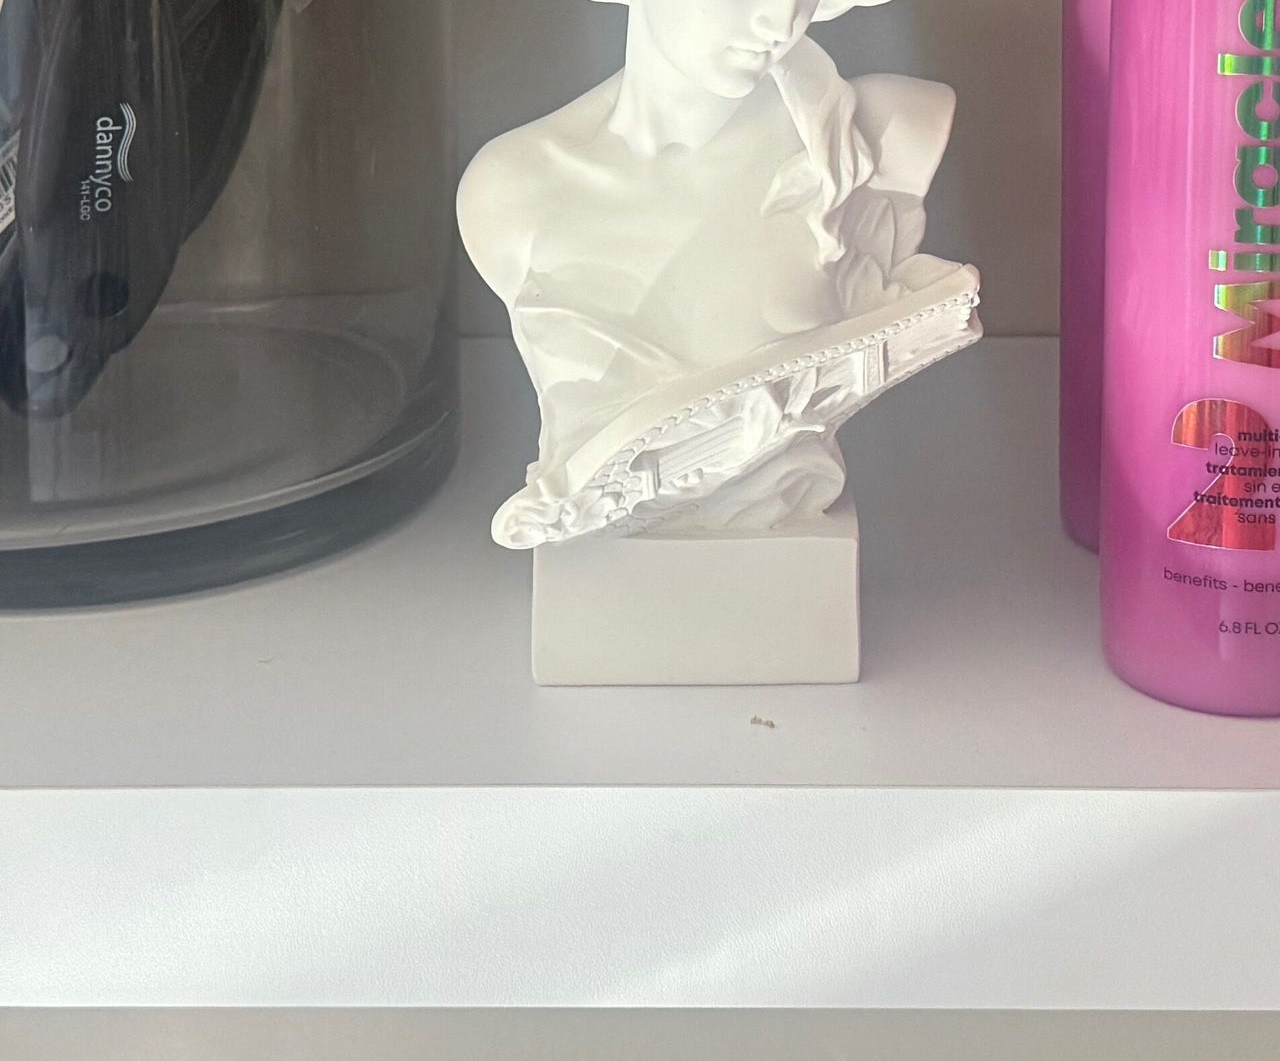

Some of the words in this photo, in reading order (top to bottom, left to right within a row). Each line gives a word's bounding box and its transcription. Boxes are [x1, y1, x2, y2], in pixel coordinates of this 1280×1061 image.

[89, 116, 122, 212] dannyco
[1215, 442, 1280, 459] leave-in
[1244, 480, 1267, 494] sin
[1194, 490, 1280, 508] traitement
[1237, 511, 1276, 524] sans
[1163, 566, 1228, 591] benefits
[1219, 620, 1242, 635] 6.8
[1245, 623, 1261, 635] FL
